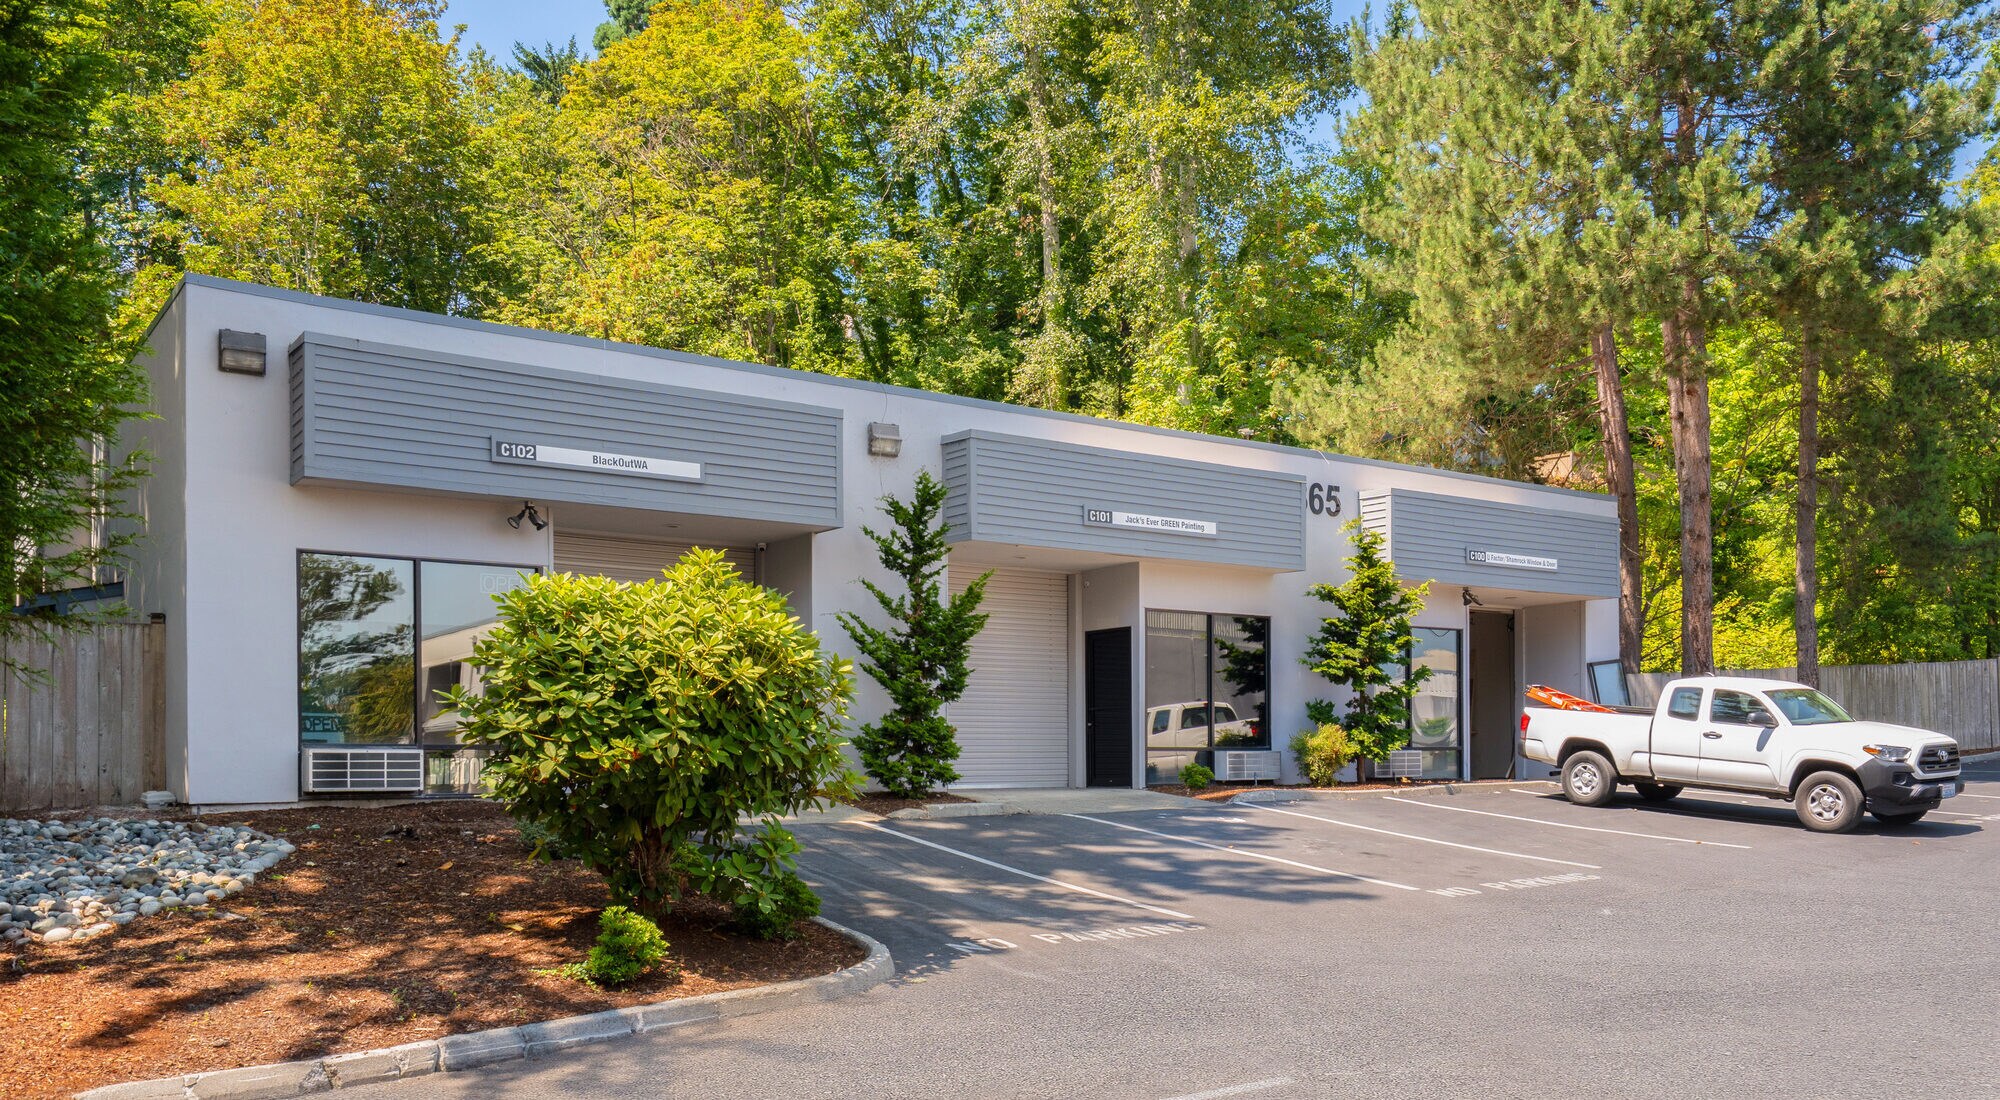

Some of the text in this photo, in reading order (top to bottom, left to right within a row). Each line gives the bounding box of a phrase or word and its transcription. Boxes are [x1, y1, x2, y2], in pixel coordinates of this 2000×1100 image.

[501, 443, 648, 470] C102 BlackOutWA
[1306, 482, 1341, 517] 65
[1089, 510, 1205, 532] C101 Jack's Ever GREEN Painting
[1470, 551, 1486, 561] C100
[483, 574, 531, 593] OPE
[304, 717, 342, 732] OPEN
[1425, 873, 1601, 897] NO PARKING
[945, 921, 1206, 954] NO PARKING
